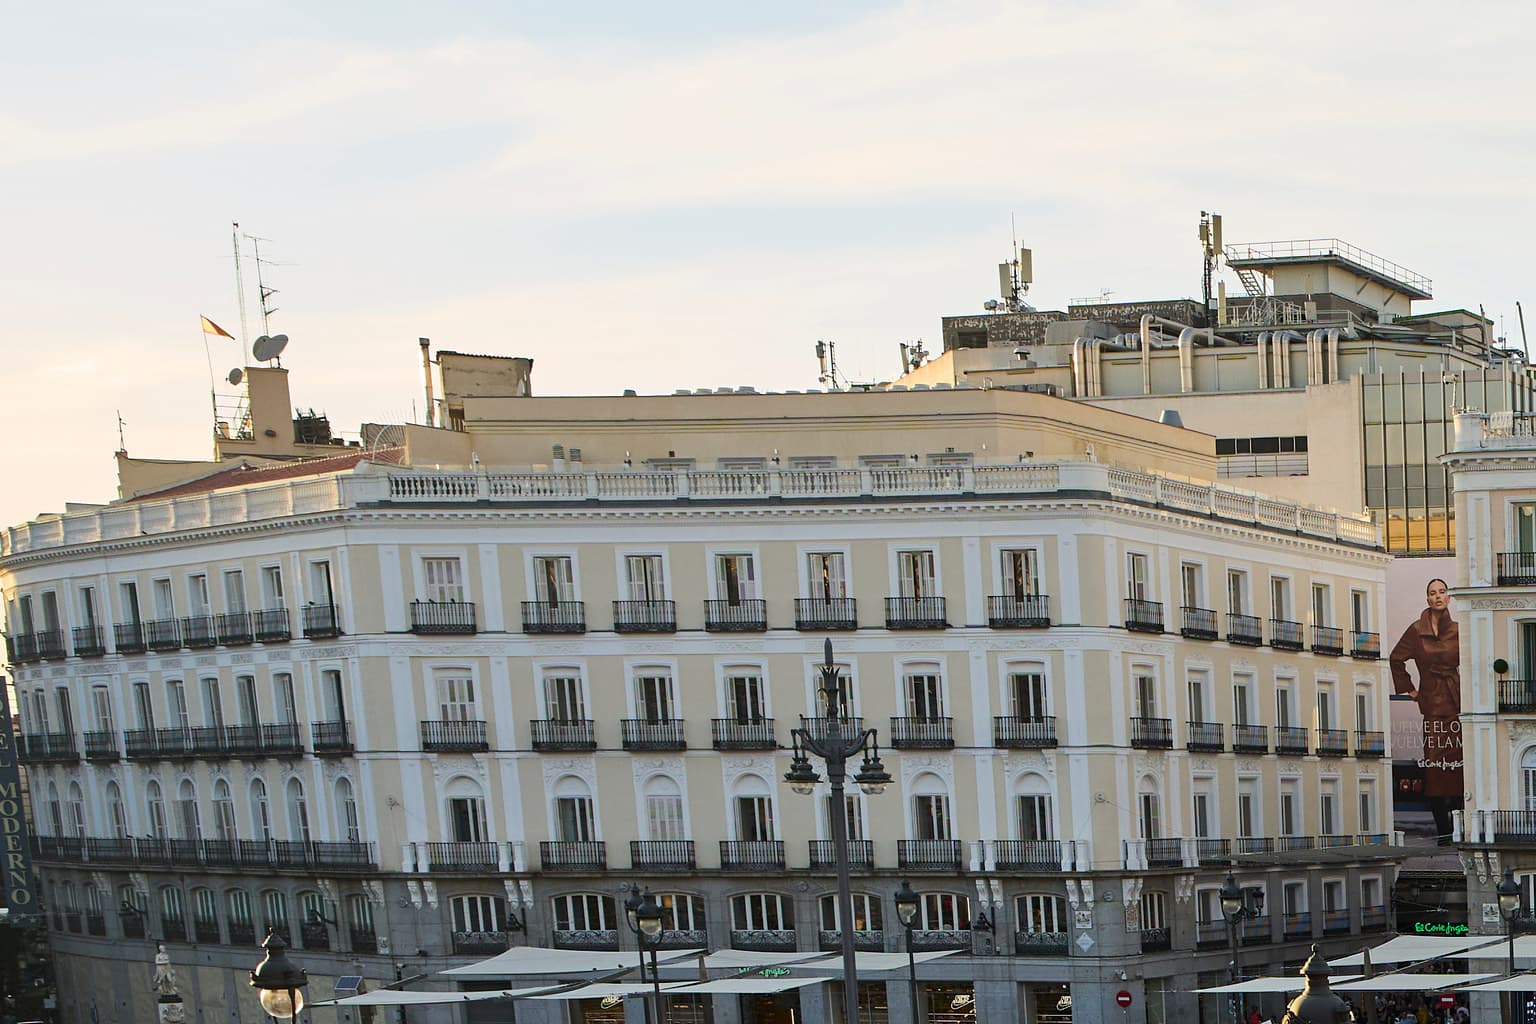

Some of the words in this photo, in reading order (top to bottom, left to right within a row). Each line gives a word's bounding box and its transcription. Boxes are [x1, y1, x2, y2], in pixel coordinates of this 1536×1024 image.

[1433, 720, 1448, 733] EL
[1437, 736, 1453, 749] LA
[0, 781, 32, 905] MODERNO
